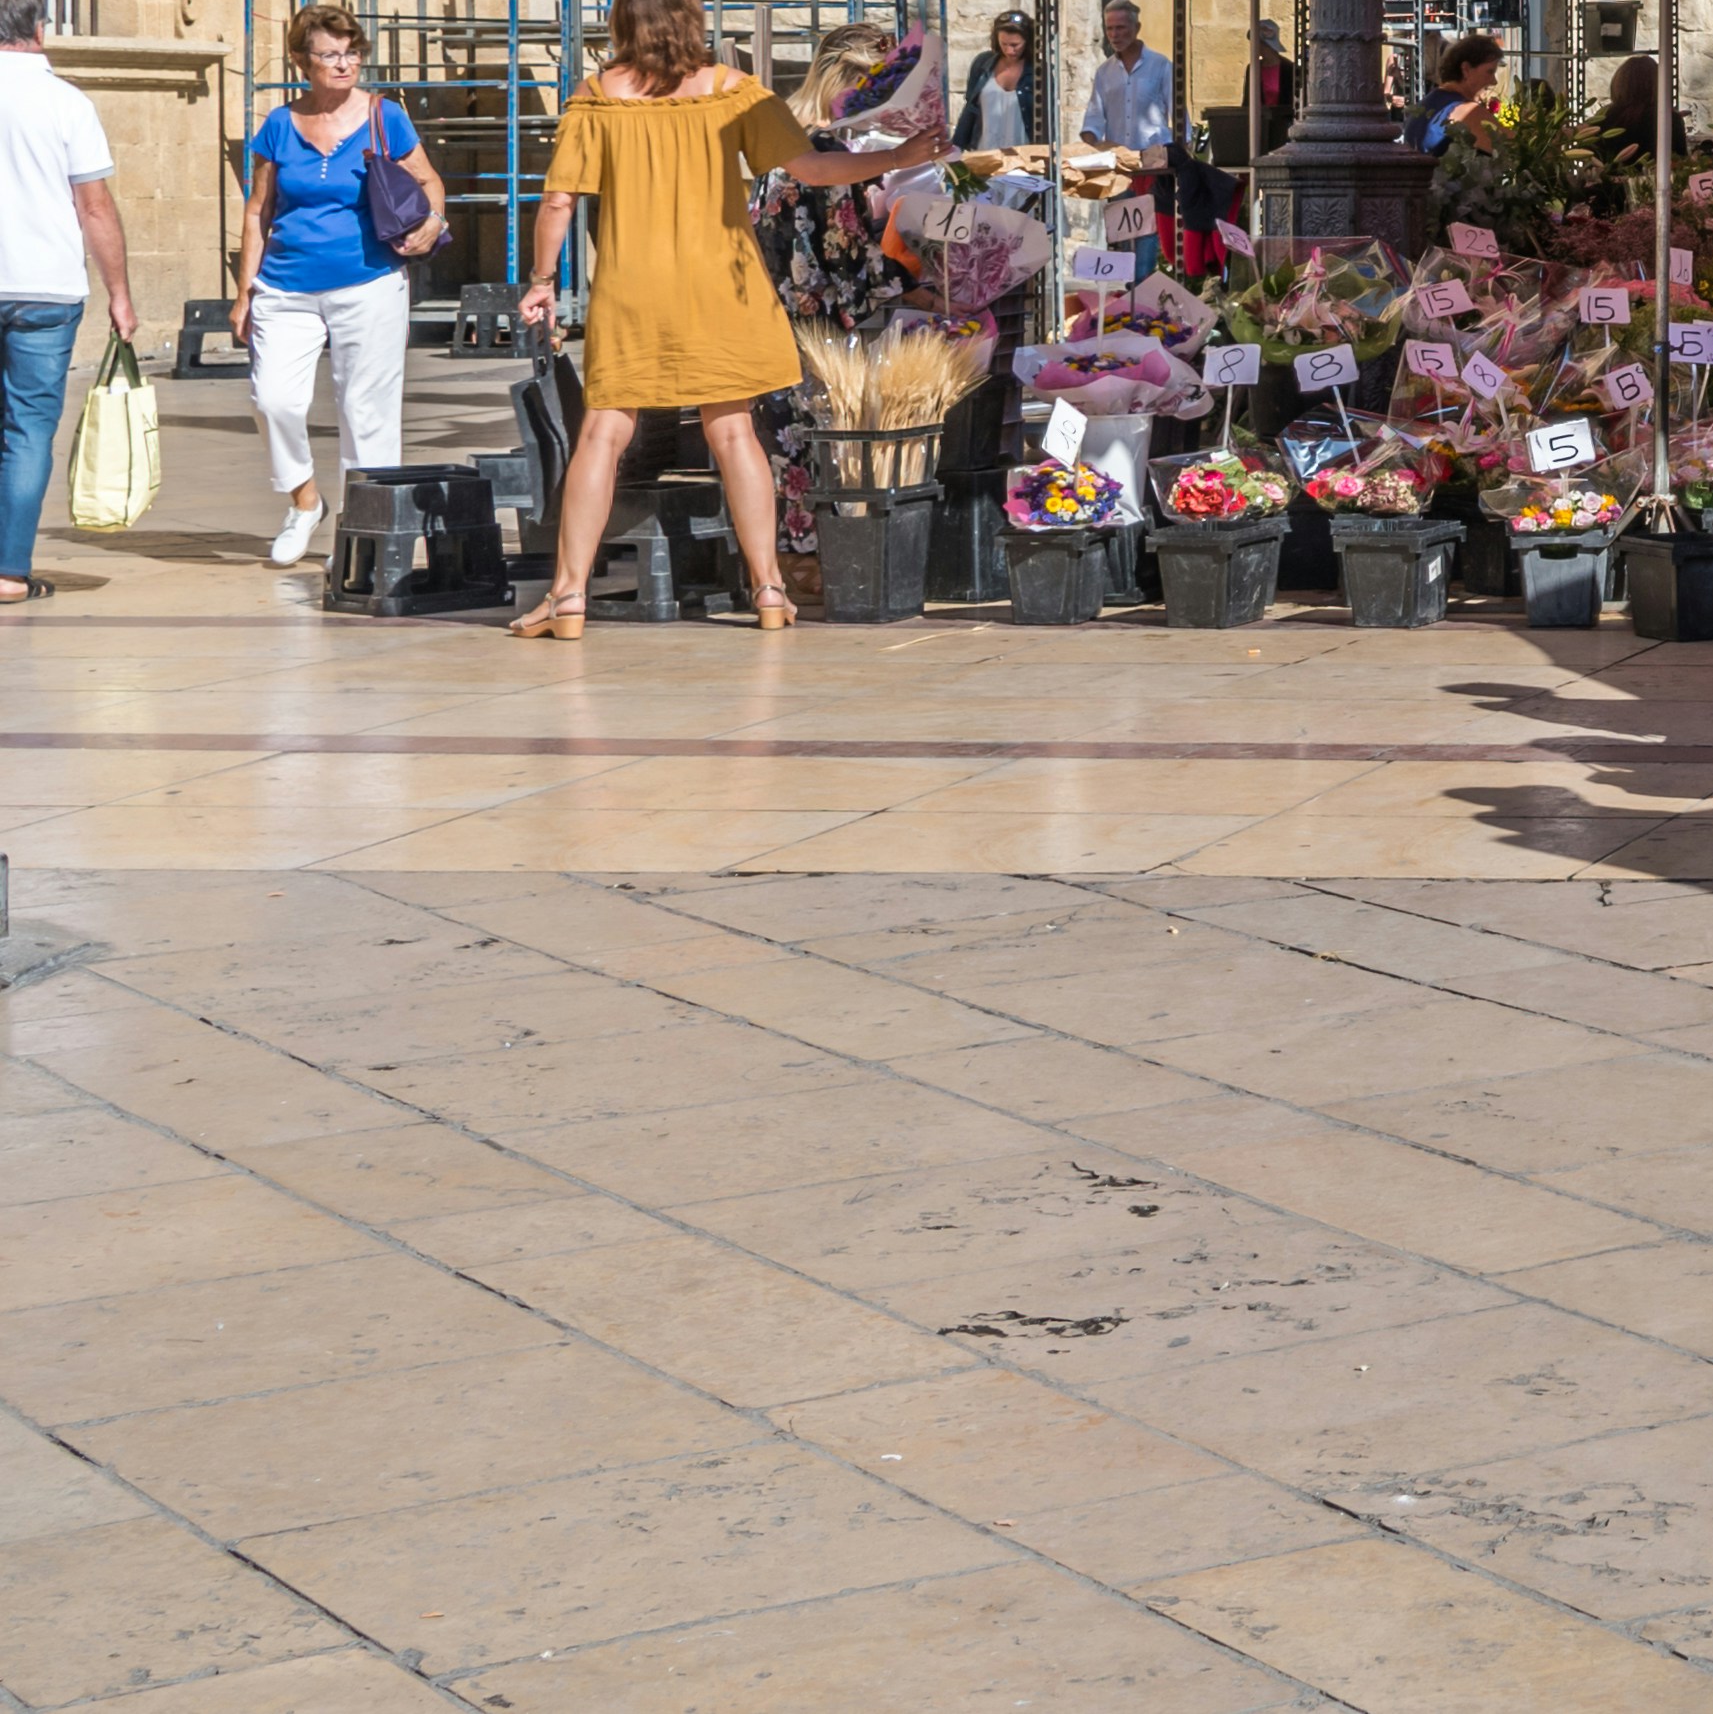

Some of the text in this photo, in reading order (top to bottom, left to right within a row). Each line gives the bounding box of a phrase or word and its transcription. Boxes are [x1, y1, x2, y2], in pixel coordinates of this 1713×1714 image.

[1117, 206, 1144, 232] 10
[1091, 256, 1114, 276] 10
[1425, 287, 1455, 315] 15
[1586, 295, 1616, 322] 15
[1218, 347, 1246, 384] 8
[1309, 352, 1344, 382] 8
[1414, 349, 1444, 371] 15
[1473, 363, 1497, 388] 8
